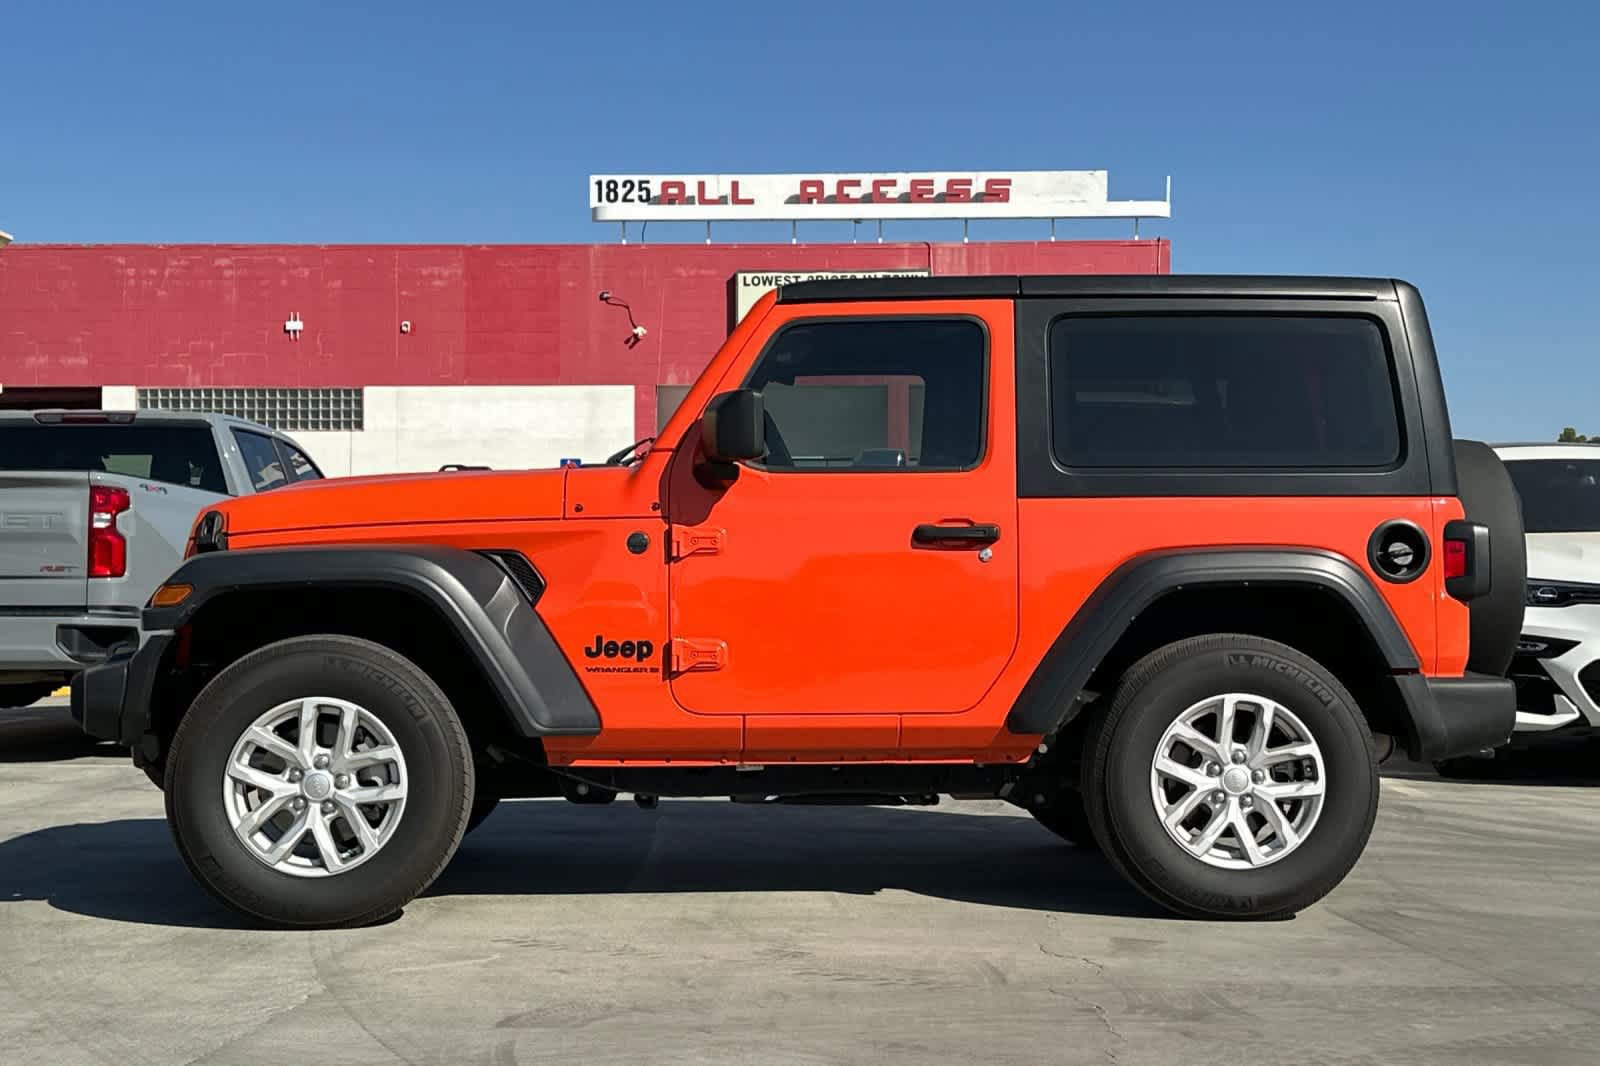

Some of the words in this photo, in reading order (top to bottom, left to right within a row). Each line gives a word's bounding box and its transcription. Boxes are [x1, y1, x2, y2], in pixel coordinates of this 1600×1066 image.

[594, 179, 651, 203] 1825
[661, 181, 755, 206] ALL
[800, 179, 1012, 204] ACCESS
[743, 275, 802, 287] LOWEST
[584, 635, 654, 663] Jeep
[1251, 655, 1335, 706] MICHELIN
